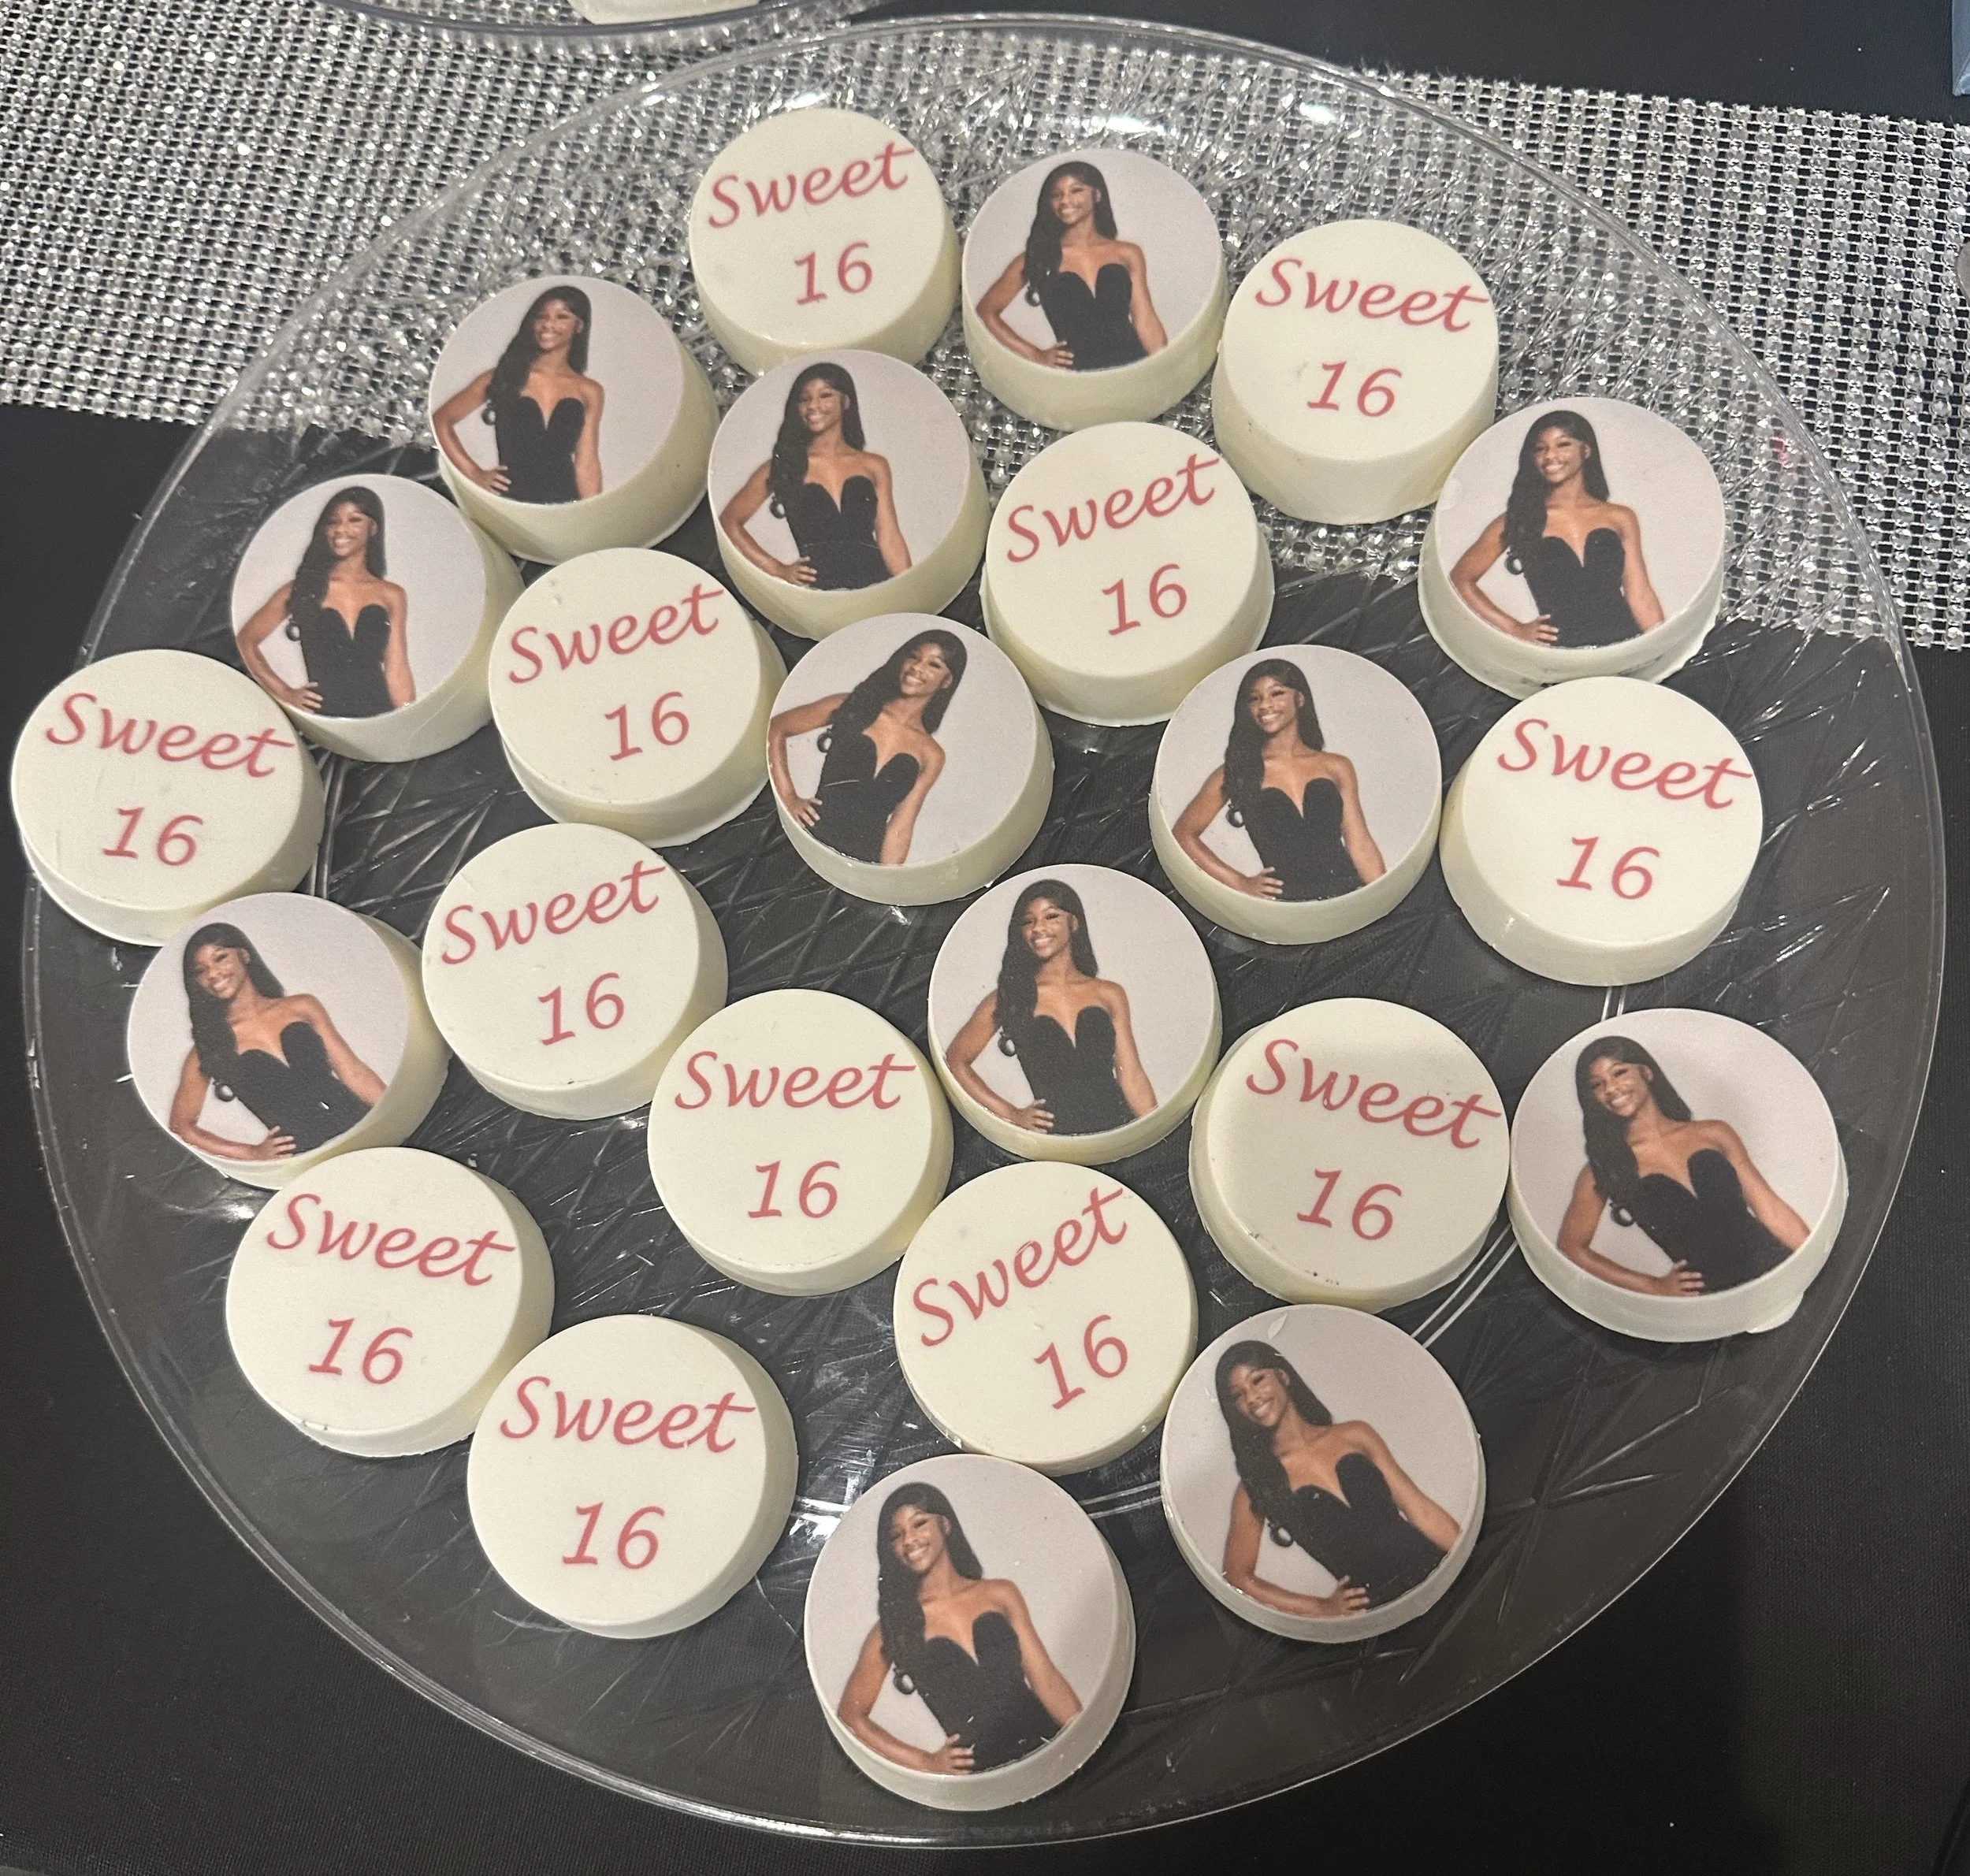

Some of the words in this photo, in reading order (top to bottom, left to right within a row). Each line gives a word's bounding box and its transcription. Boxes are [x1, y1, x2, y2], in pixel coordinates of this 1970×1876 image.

[708, 140, 914, 228] Sweet
[796, 241, 873, 305] 16
[1254, 257, 1488, 332] Sweet
[1307, 361, 1400, 417] 16
[1007, 455, 1219, 563] Sweet
[508, 583, 725, 684] Sweet
[1102, 563, 1188, 636] 16
[45, 692, 295, 778] Sweet
[605, 690, 690, 762] 16
[1496, 719, 1752, 810] Sweet
[102, 807, 203, 866] 16
[1556, 837, 1660, 900] 16
[441, 860, 665, 965] Sweet
[538, 971, 625, 1046] 16
[675, 1050, 914, 1110] Sweet
[1246, 1038, 1501, 1150] Sweet
[748, 1161, 840, 1219] 16
[1297, 1169, 1403, 1240] 16
[266, 1193, 515, 1288] Sweet
[913, 1187, 1128, 1350] Sweet
[307, 1318, 413, 1385] 16
[1034, 1314, 1128, 1410] 16
[500, 1376, 755, 1454] Sweet
[562, 1502, 666, 1570] 16
